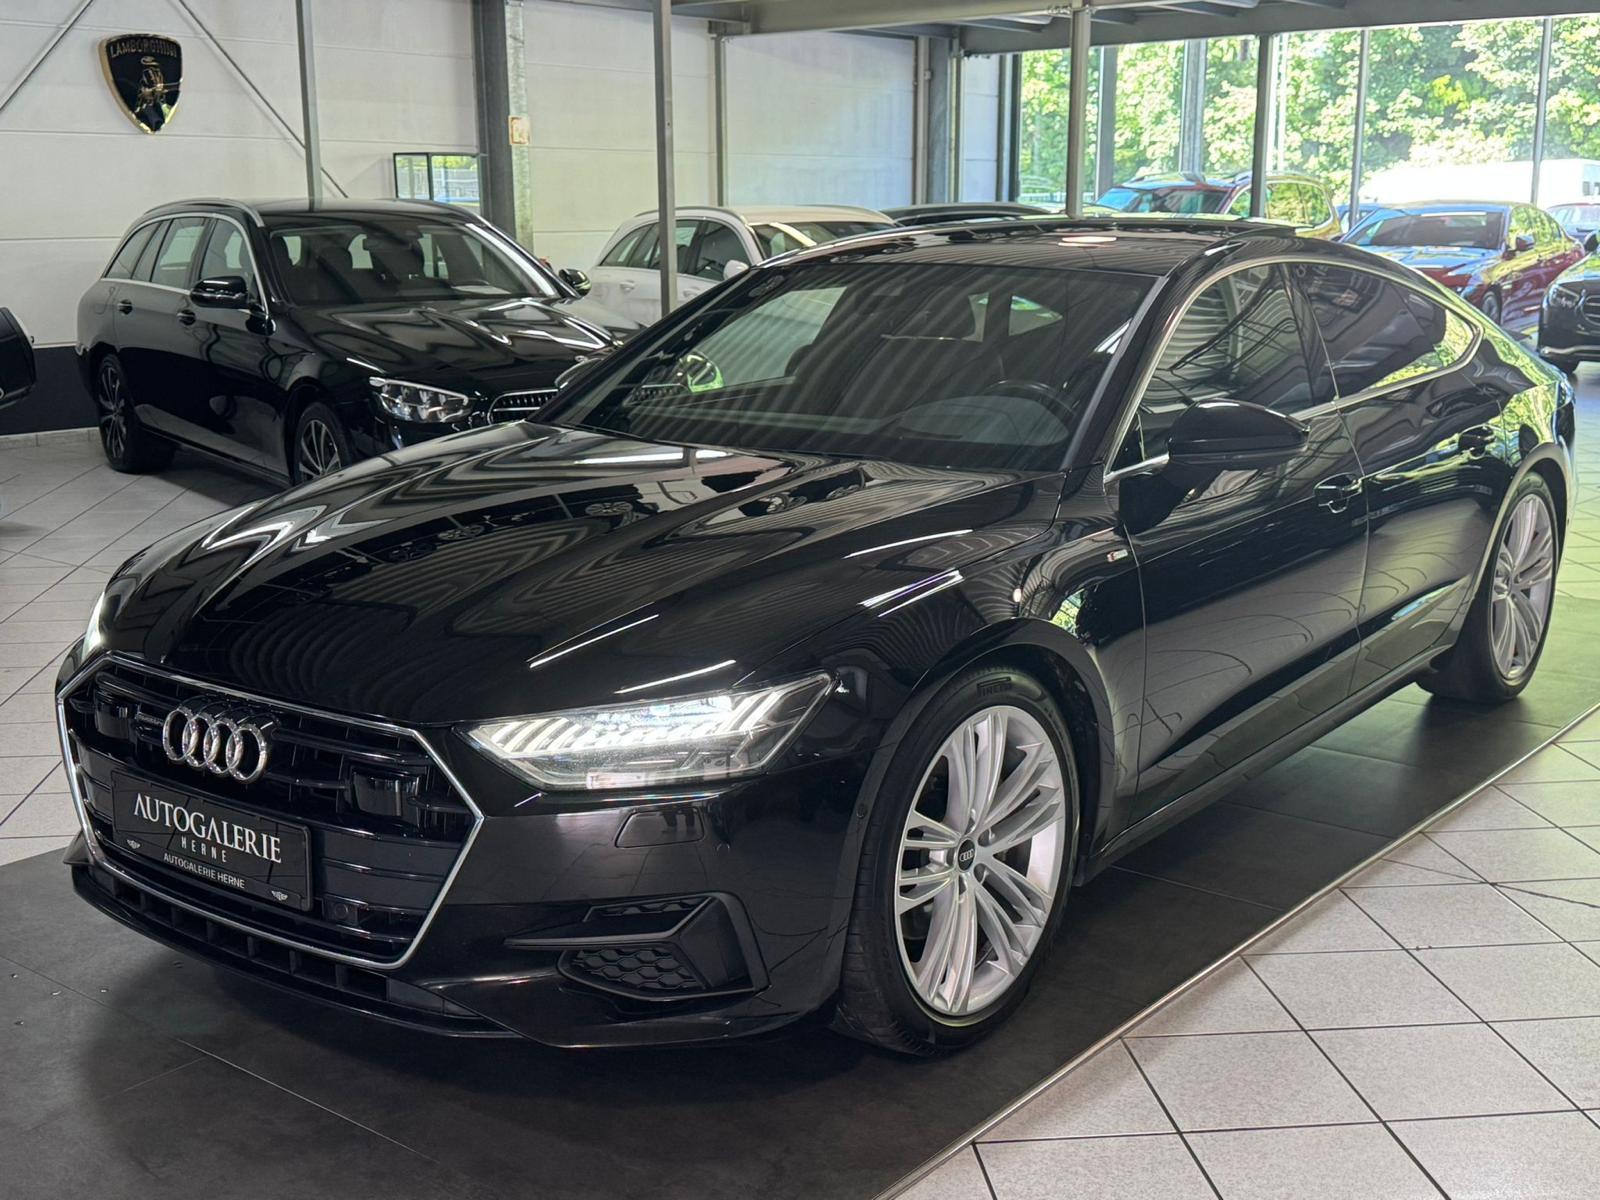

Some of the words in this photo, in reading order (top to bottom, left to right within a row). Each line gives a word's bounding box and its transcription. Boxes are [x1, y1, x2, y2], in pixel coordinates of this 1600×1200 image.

[134, 793, 282, 863] AUTOGALERIE
[181, 836, 228, 863] HERNE
[163, 853, 216, 880] AUTOGALERIE
[217, 873, 246, 889] HERNE
